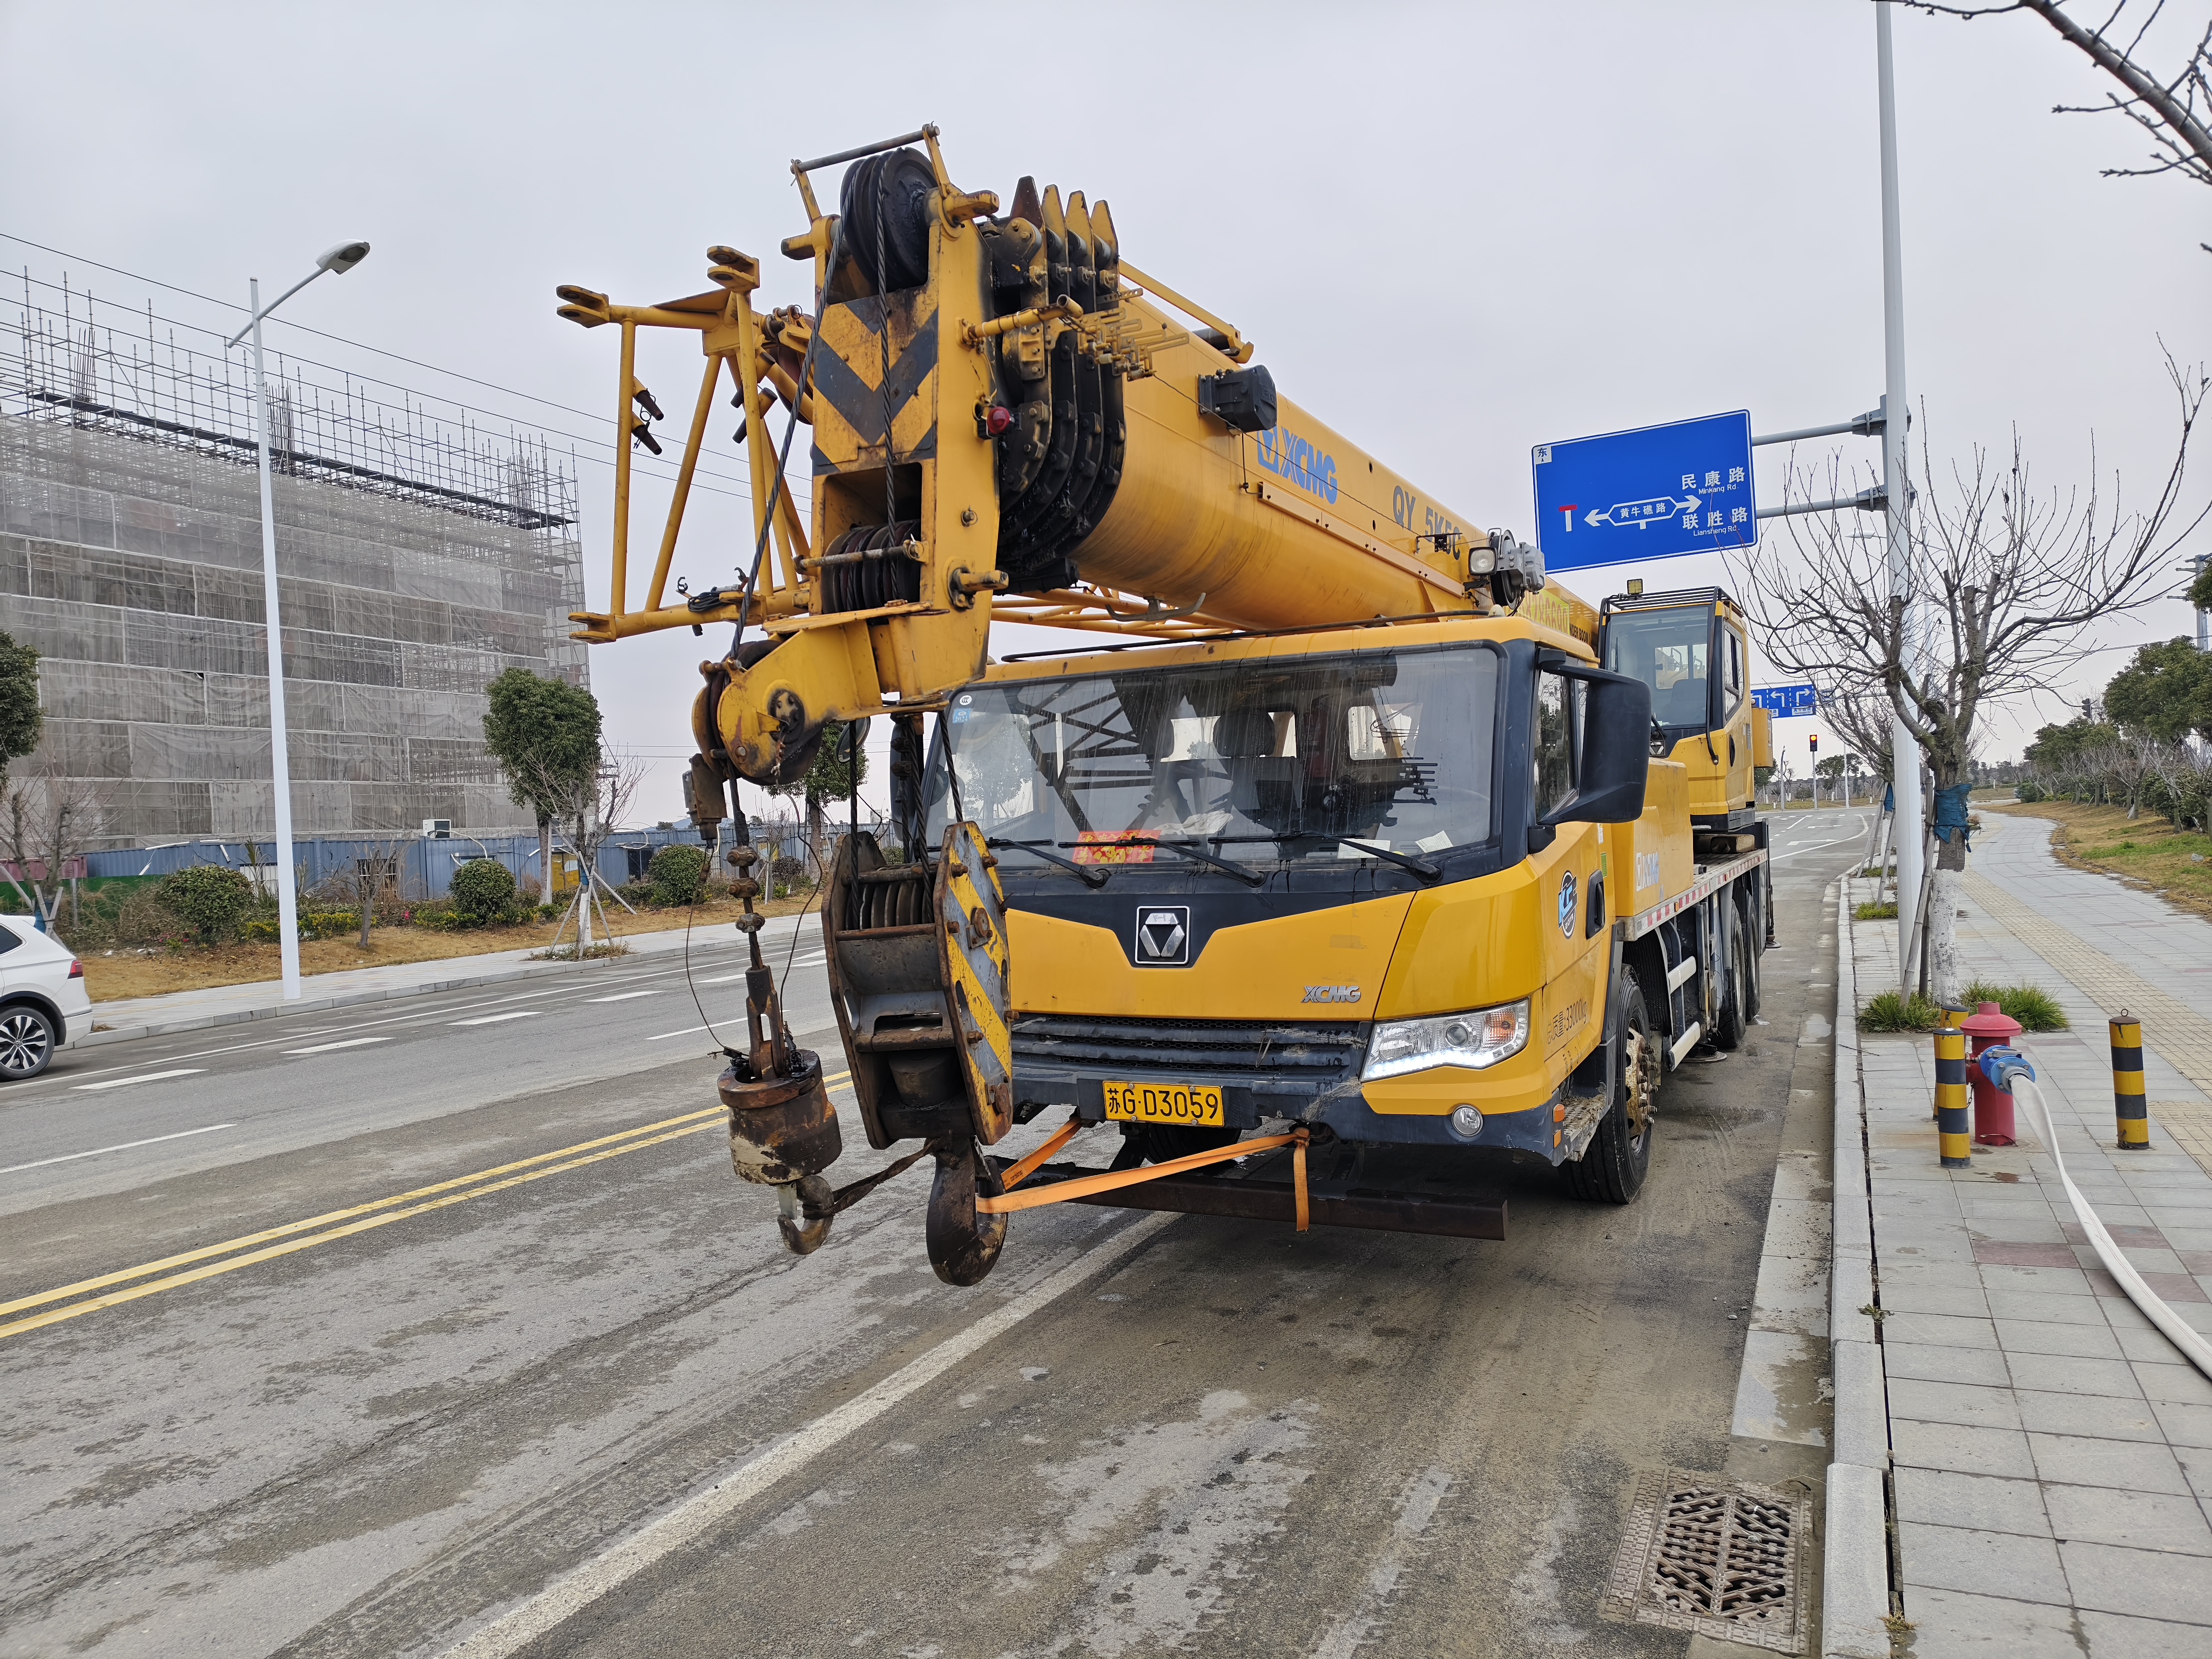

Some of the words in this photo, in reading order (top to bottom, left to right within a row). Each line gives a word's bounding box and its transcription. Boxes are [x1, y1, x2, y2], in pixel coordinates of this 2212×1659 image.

[1537, 447, 1547, 457] 东
[1281, 426, 1338, 504] XCMG
[1682, 466, 1745, 490] 民康路
[1698, 486, 1725, 495] Minkang
[1393, 485, 1416, 531] QY
[1620, 502, 1666, 519] 黄牛礁路
[1682, 507, 1748, 530] 联胜路
[1693, 526, 1727, 536] Liansheng
[1301, 985, 1361, 1003] XCMG
